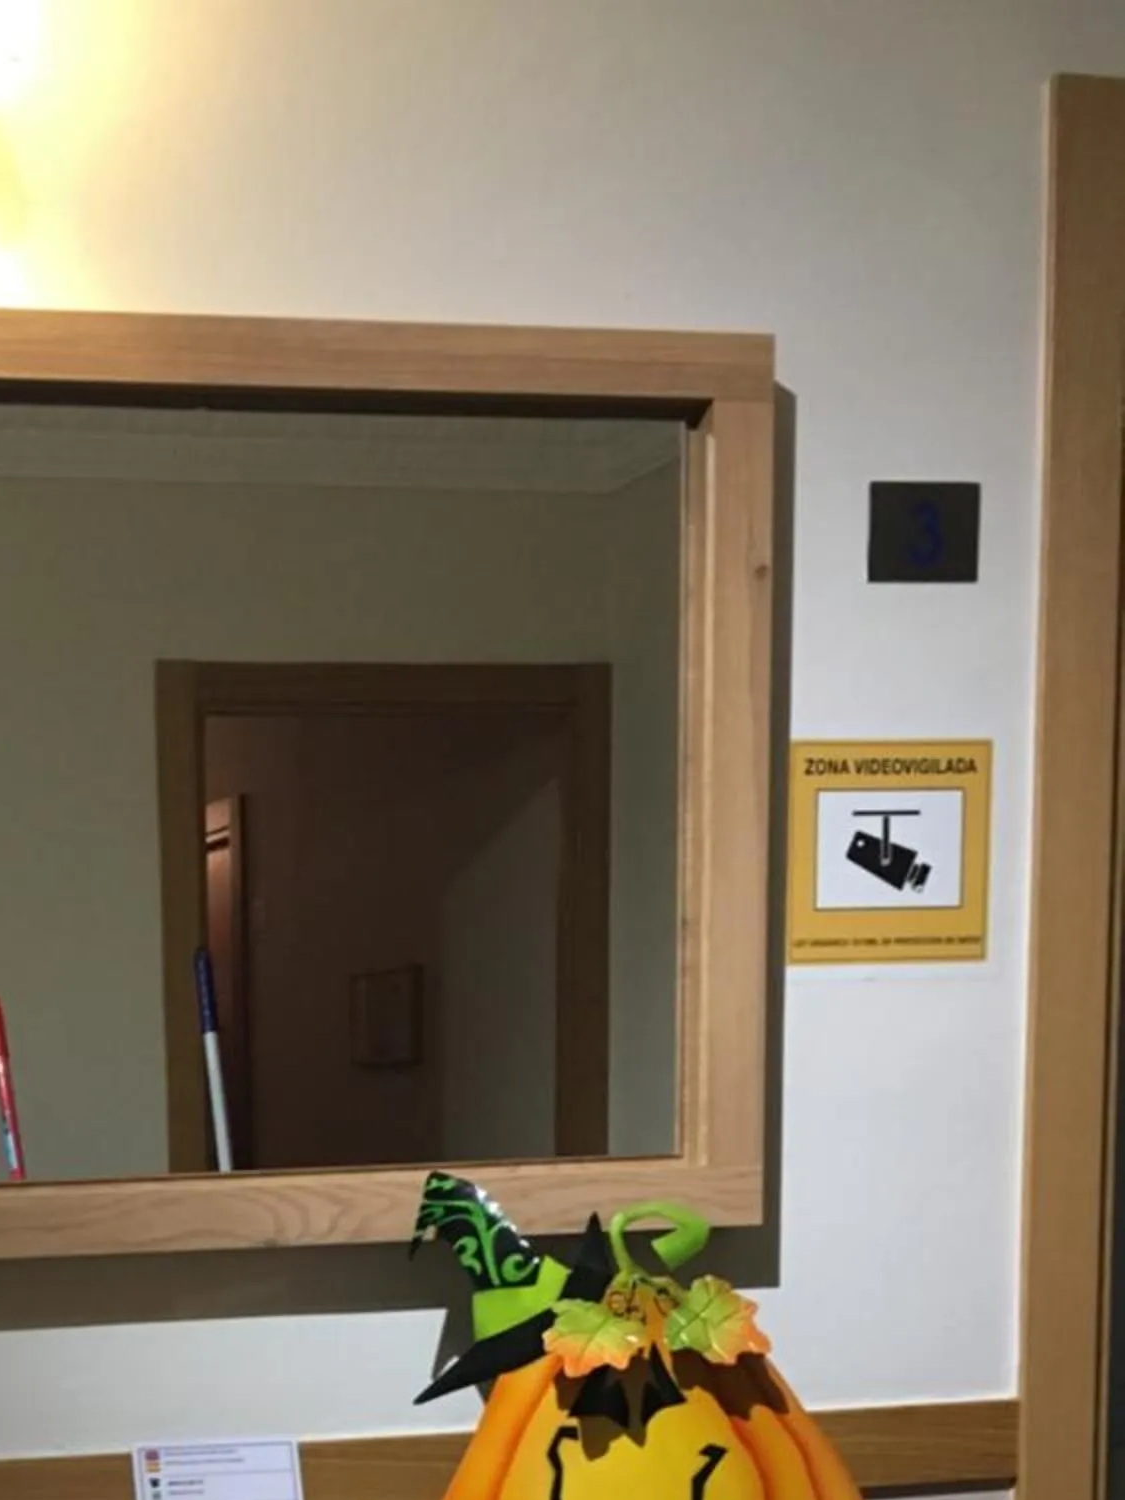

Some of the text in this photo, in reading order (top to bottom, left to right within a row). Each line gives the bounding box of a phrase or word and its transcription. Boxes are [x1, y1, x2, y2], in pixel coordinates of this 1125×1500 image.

[907, 501, 944, 568] 3
[804, 756, 978, 776] ZONA VIDEOVIGILADA
